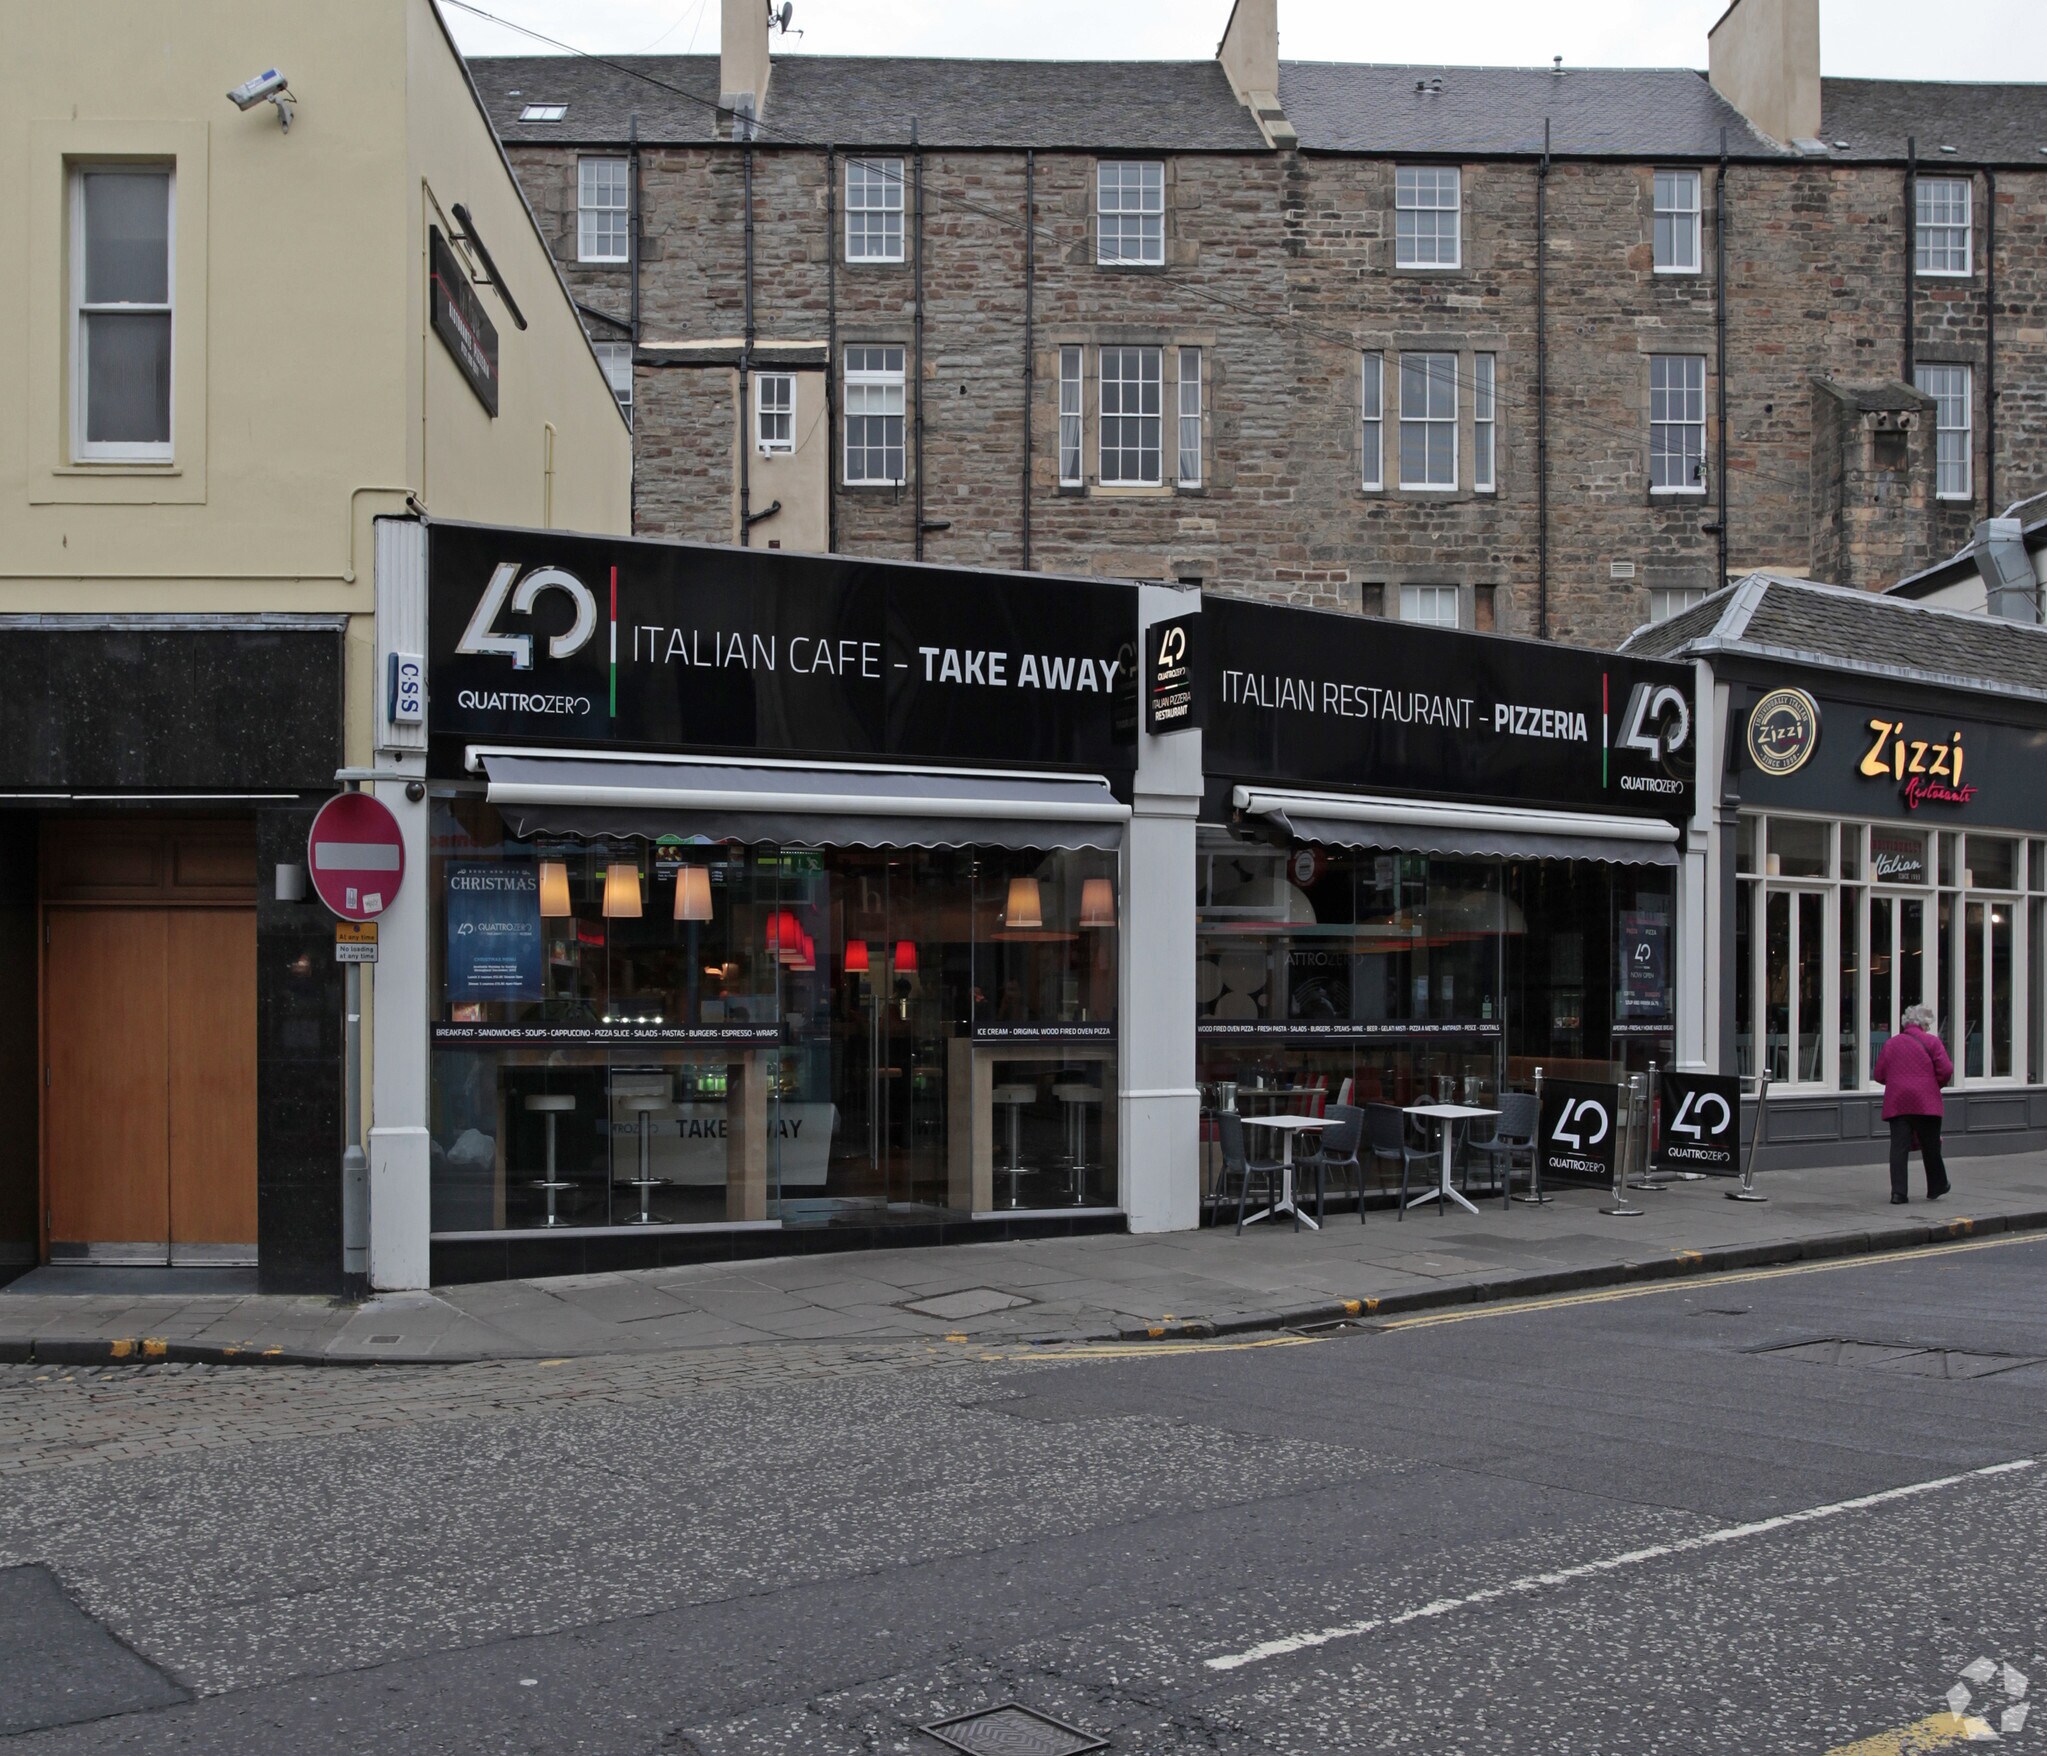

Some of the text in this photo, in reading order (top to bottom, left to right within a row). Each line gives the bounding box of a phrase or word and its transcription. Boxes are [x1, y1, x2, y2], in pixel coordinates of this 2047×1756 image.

[633, 625, 776, 671] ITALIAN
[789, 636, 882, 679] CAFE
[918, 646, 1008, 686] TAKE
[1017, 654, 1120, 694] AWAY
[457, 690, 591, 715] QUATTROZERO
[1169, 691, 1192, 706] PIZZERIA
[1222, 670, 1315, 713] ITALIAN
[1323, 682, 1474, 729] RESTAURANT
[1495, 703, 1588, 742] PIZZERIA
[1155, 704, 1188, 721] RESTAURANT
[1755, 696, 1809, 727] INDIVIDUALLY ITALIAN
[1758, 721, 1803, 744] Zizzi
[1762, 754, 1798, 767] SINCE 1999
[1860, 719, 1963, 788] Zizzi
[1620, 775, 1684, 794] QUATTROZERO
[1905, 776, 1978, 809] Ristorante
[1876, 853, 1922, 876] Italian
[451, 876, 537, 891] CHRISTMAS
[478, 922, 533, 932] QUATTROZERO
[436, 1029, 474, 1037] BREAKFAST
[478, 1029, 521, 1037] SANDWICHES
[525, 1029, 547, 1037] SOUPS
[551, 1029, 591, 1037] CAPPUCCINO
[594, 1029, 613, 1037] PIZZA
[1551, 1097, 1609, 1150] 40
[1670, 1091, 1731, 1140] 40
[676, 1119, 727, 1139] TAKE
[1668, 1147, 1730, 1162] QUATTROZERO
[1549, 1157, 1606, 1174] QUATTROZERO
